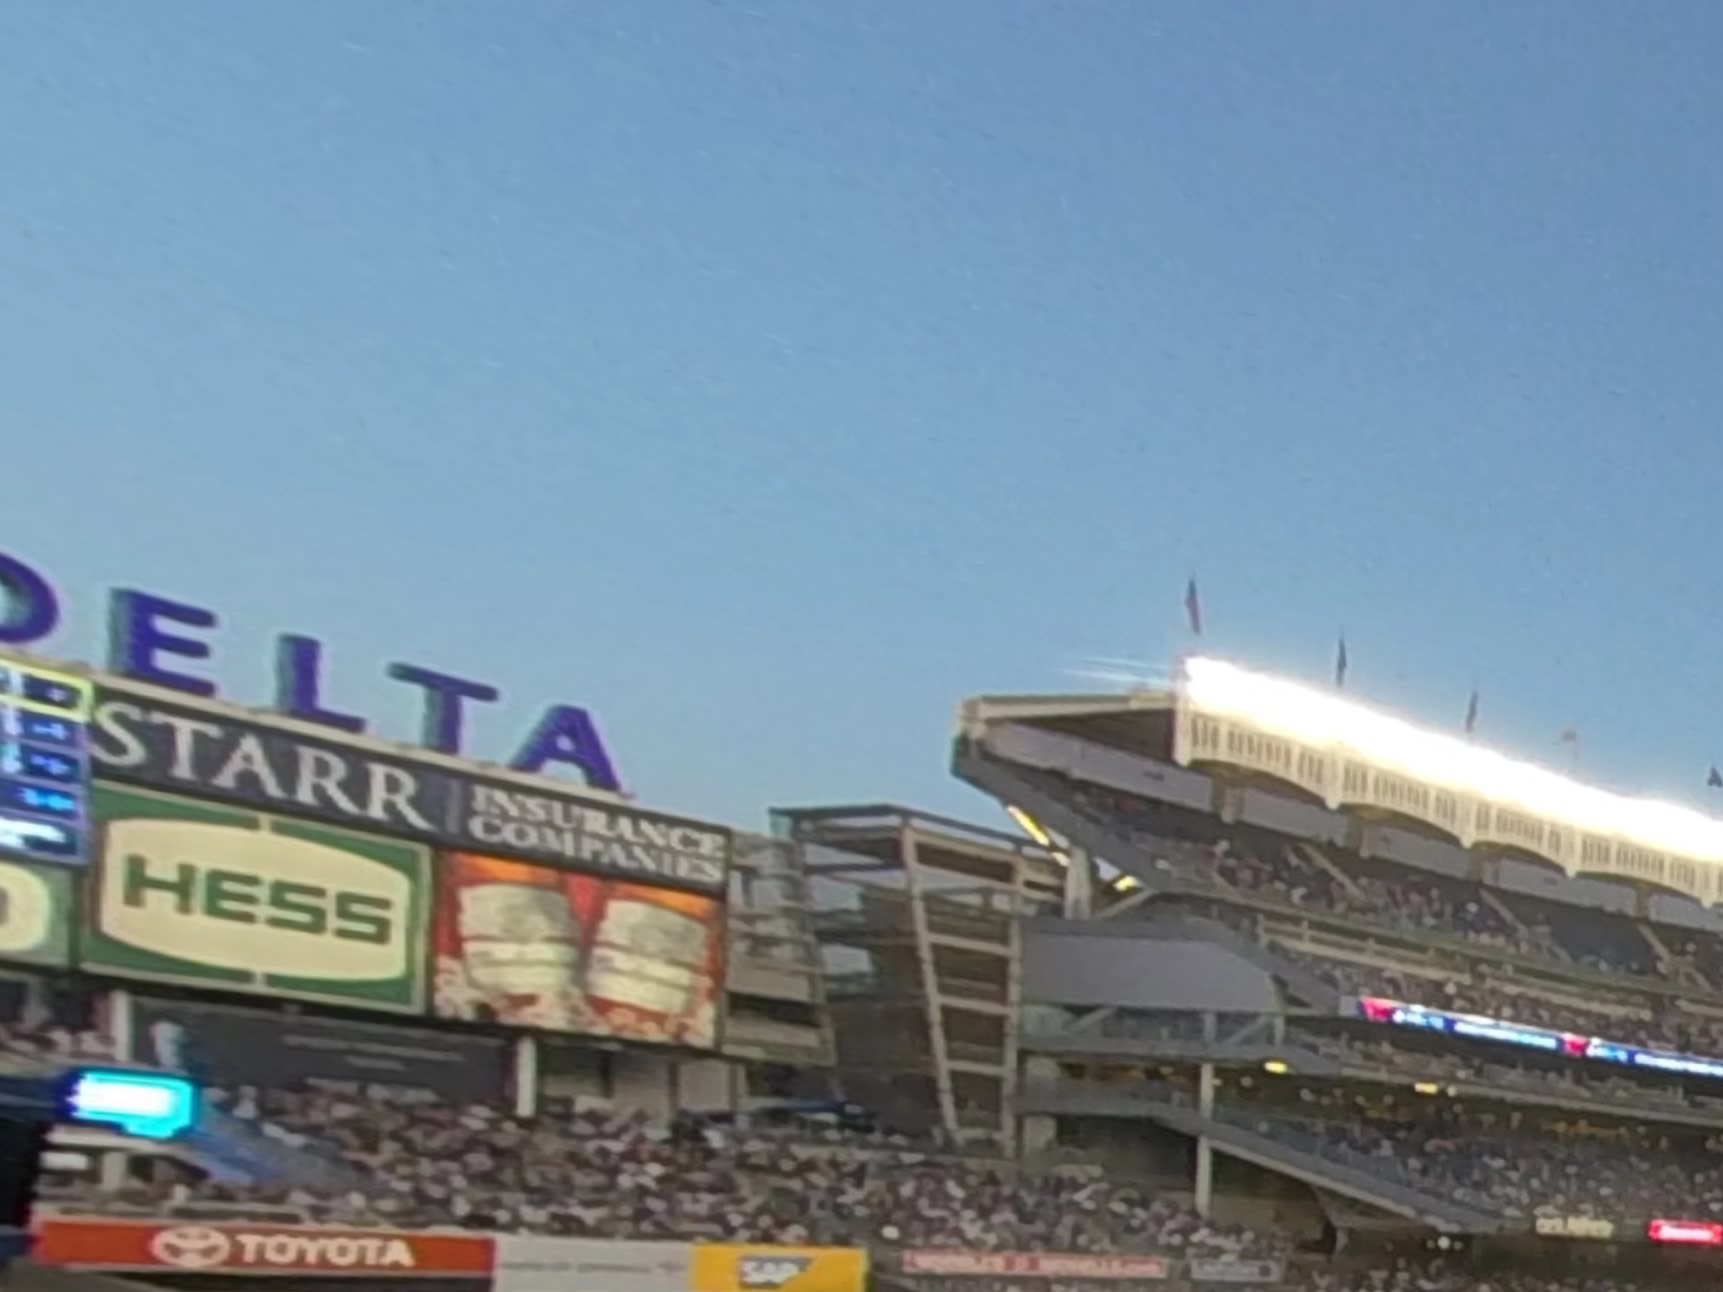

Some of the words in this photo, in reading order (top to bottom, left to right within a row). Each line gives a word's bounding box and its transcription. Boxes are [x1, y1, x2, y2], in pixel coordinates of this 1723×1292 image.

[92, 702, 436, 831] STARR
[467, 815, 725, 884] COMPANIES
[471, 784, 729, 859] INSURANCE
[122, 854, 393, 945] HESS
[236, 1233, 416, 1268] TOYOTA
[740, 1260, 800, 1287] SAP
